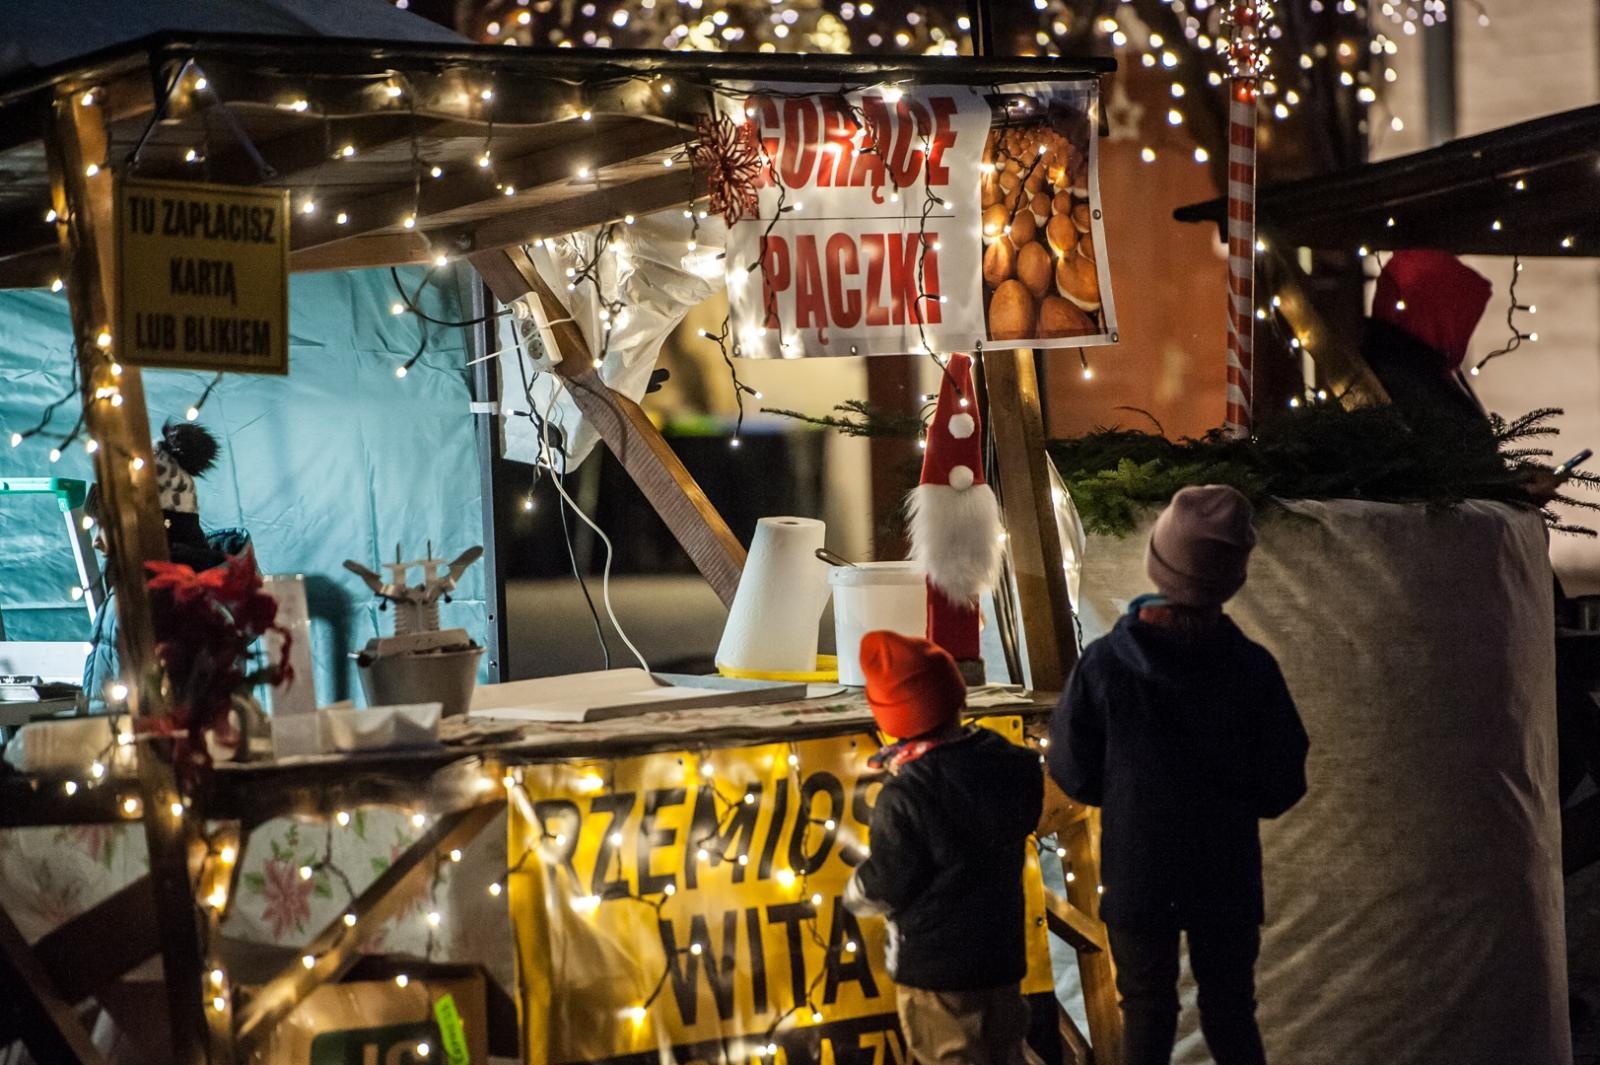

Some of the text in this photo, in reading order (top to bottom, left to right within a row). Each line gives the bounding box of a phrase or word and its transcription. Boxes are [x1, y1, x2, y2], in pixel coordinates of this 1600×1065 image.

[744, 95, 958, 204] GORĄCE
[128, 196, 276, 244] TU ZAPŁACISZ
[170, 256, 237, 307] KARTĄ
[759, 232, 942, 345] PĄCZKI
[136, 312, 271, 356] LUB BLIKIEM
